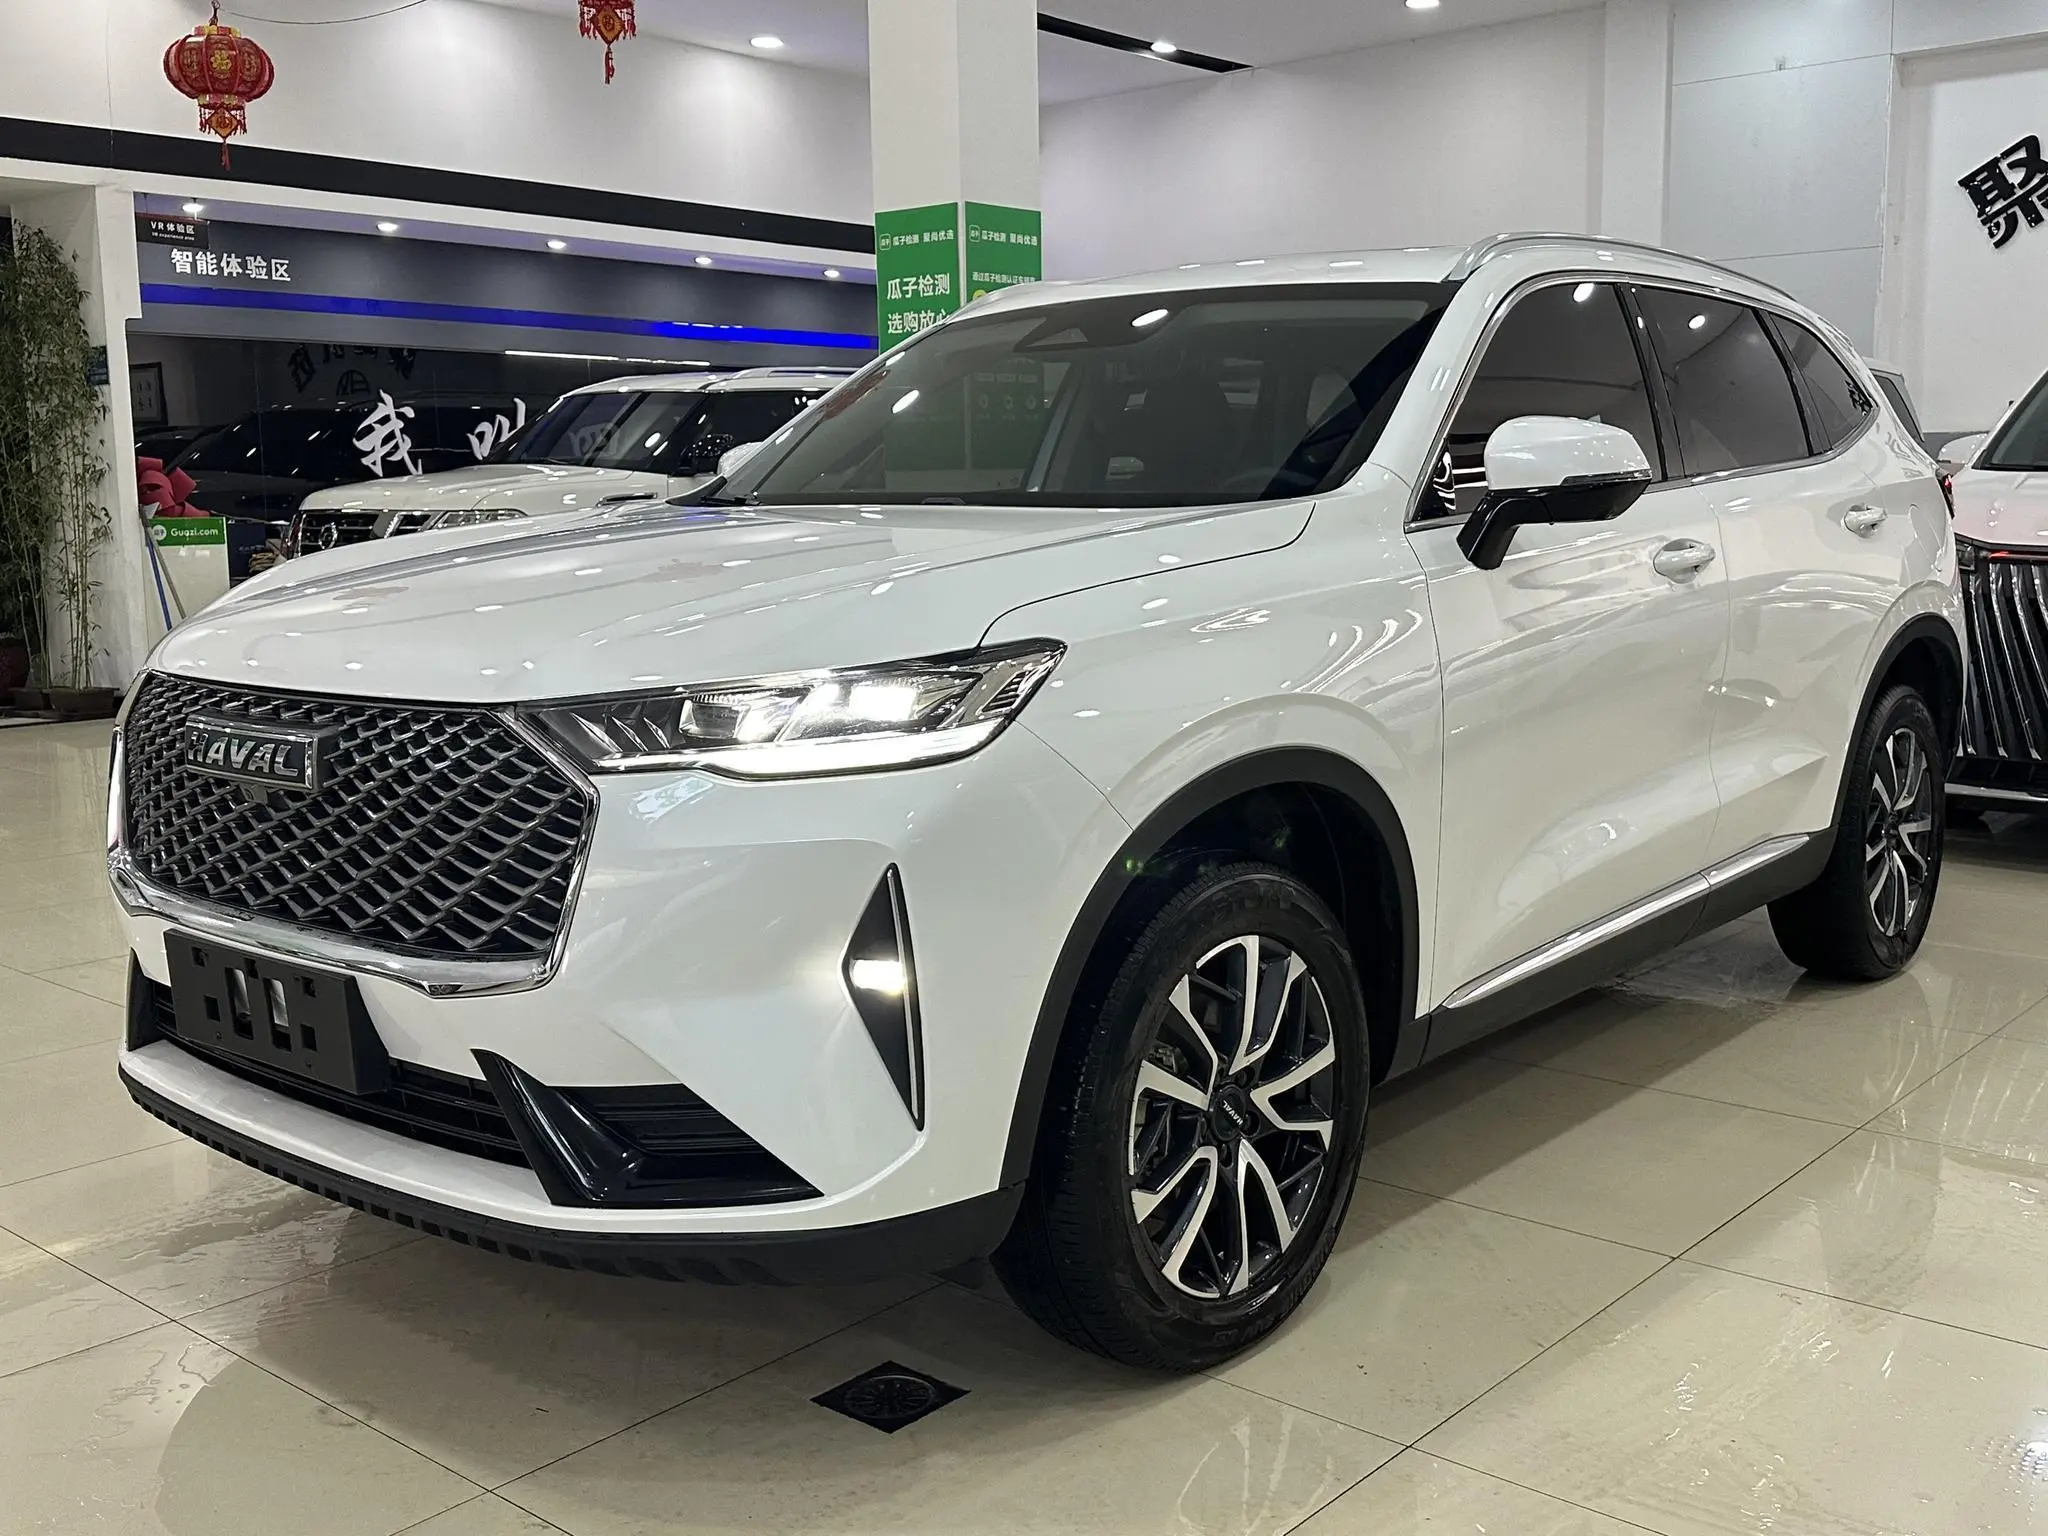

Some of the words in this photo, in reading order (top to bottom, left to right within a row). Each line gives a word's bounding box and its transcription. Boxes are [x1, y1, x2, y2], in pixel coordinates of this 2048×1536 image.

[1957, 134, 2048, 249] 聚
[151, 221, 164, 230] VR
[166, 222, 195, 235] 体验区
[171, 248, 291, 282] 智能体验区
[886, 272, 950, 300] 瓜子检测
[887, 308, 950, 334] 选购放心
[187, 731, 299, 777] HAVAL
[1223, 1100, 1243, 1126] HAVAL
